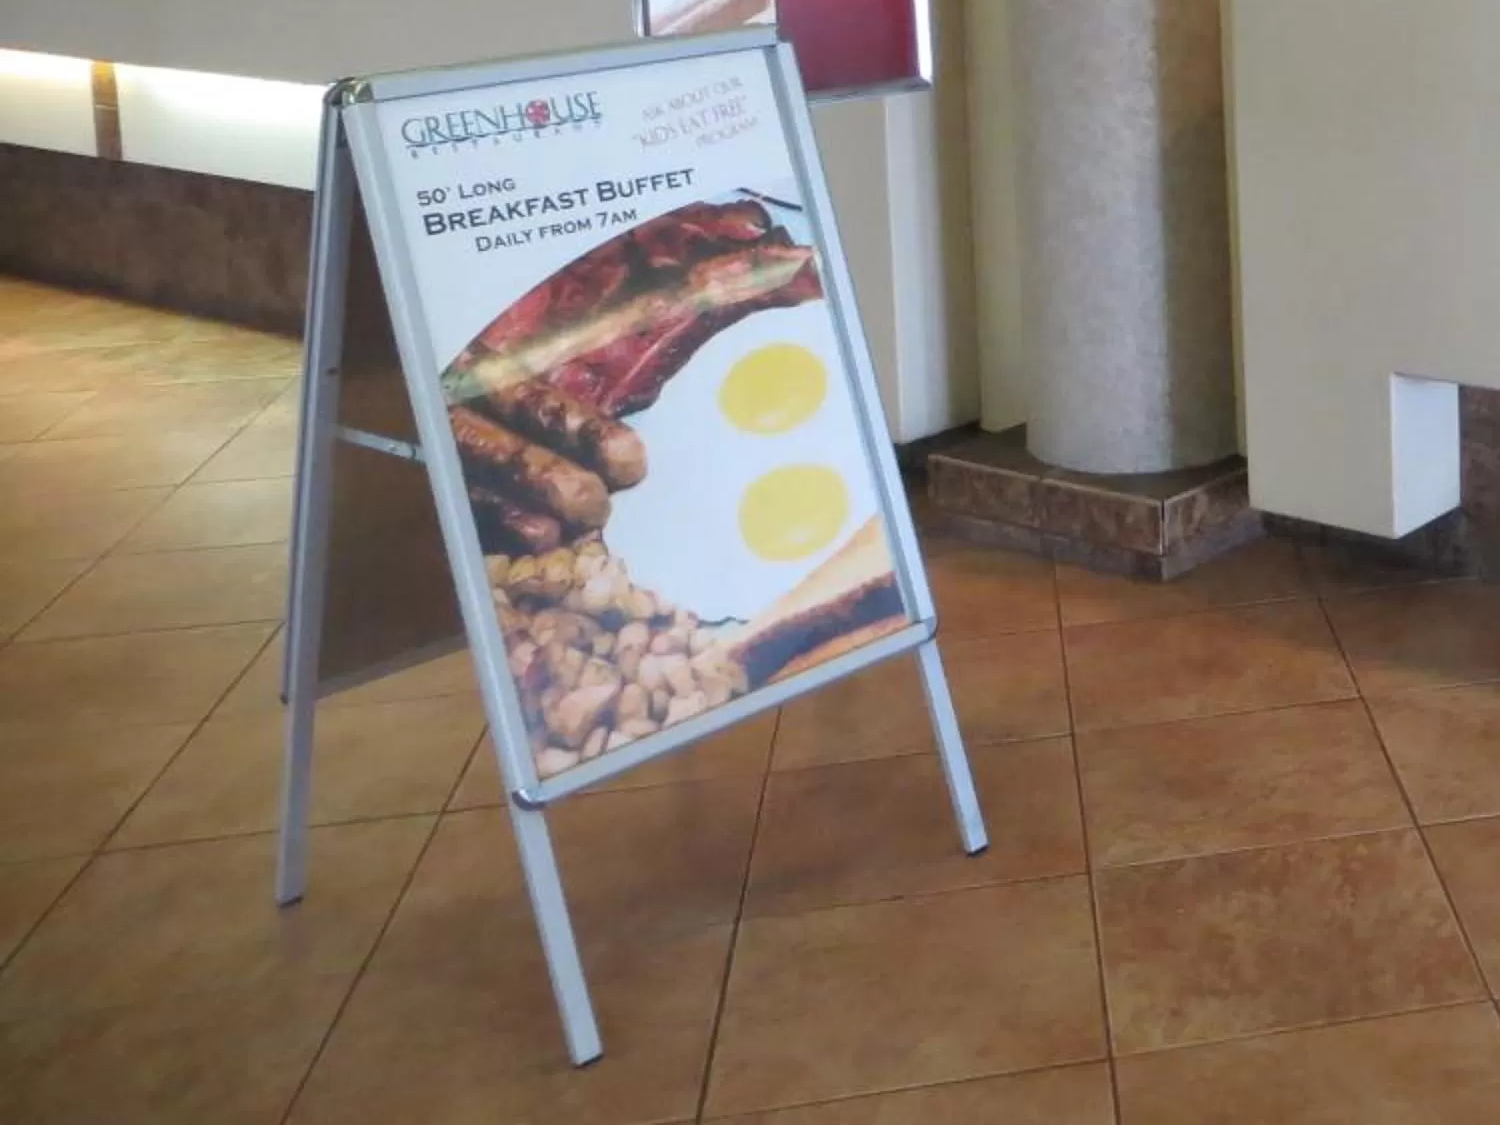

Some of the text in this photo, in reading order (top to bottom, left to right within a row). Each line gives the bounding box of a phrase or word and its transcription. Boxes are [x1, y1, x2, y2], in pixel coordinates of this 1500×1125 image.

[401, 91, 602, 146] GREENHOUSE
[423, 168, 696, 236] BREAKFAST BUFFET
[458, 177, 517, 201] LONG
[475, 208, 638, 253] DAILY FROM 7AM
